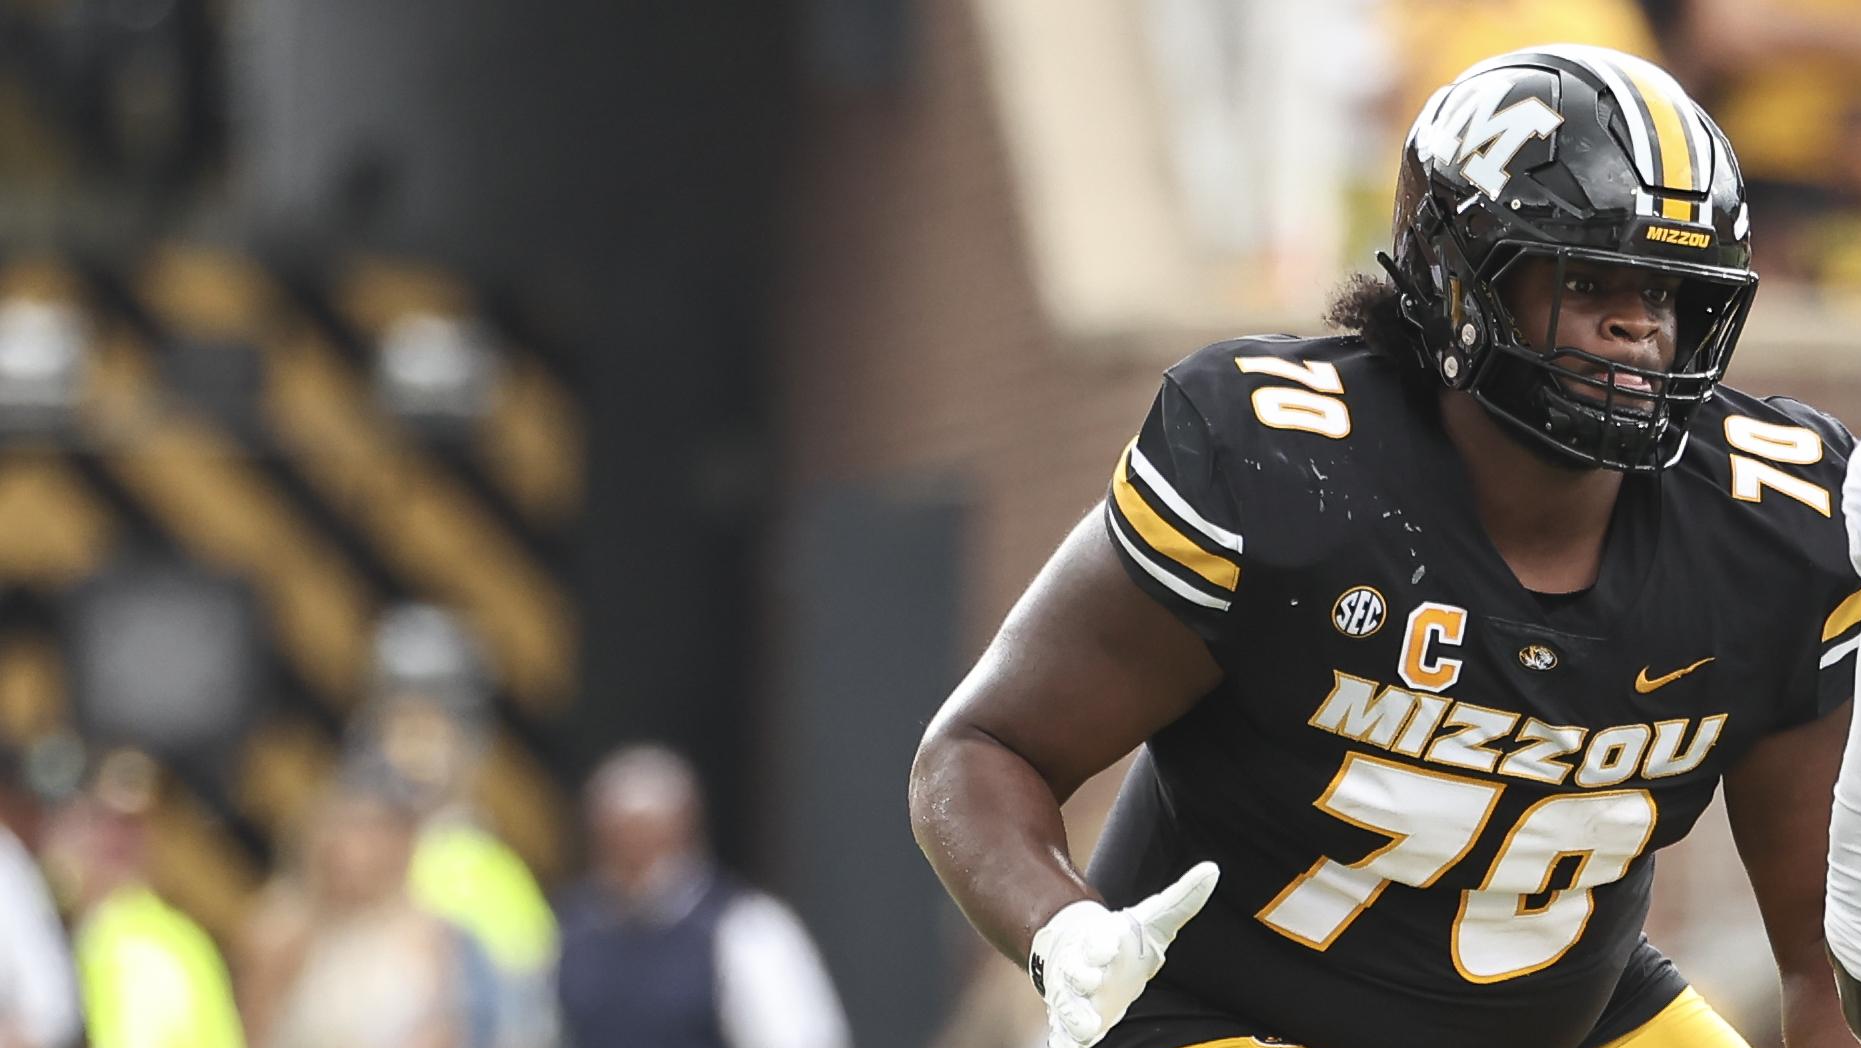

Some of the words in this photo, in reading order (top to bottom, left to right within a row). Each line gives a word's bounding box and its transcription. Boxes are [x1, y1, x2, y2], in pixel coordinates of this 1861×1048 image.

[1417, 78, 1565, 202] M
[1646, 226, 1711, 249] MIZZOU
[1724, 414, 1831, 518] 70
[1336, 590, 1383, 635] SEC
[1398, 602, 1467, 693] C
[1307, 670, 1728, 788] MIZZOU
[1254, 751, 1656, 984] 70
